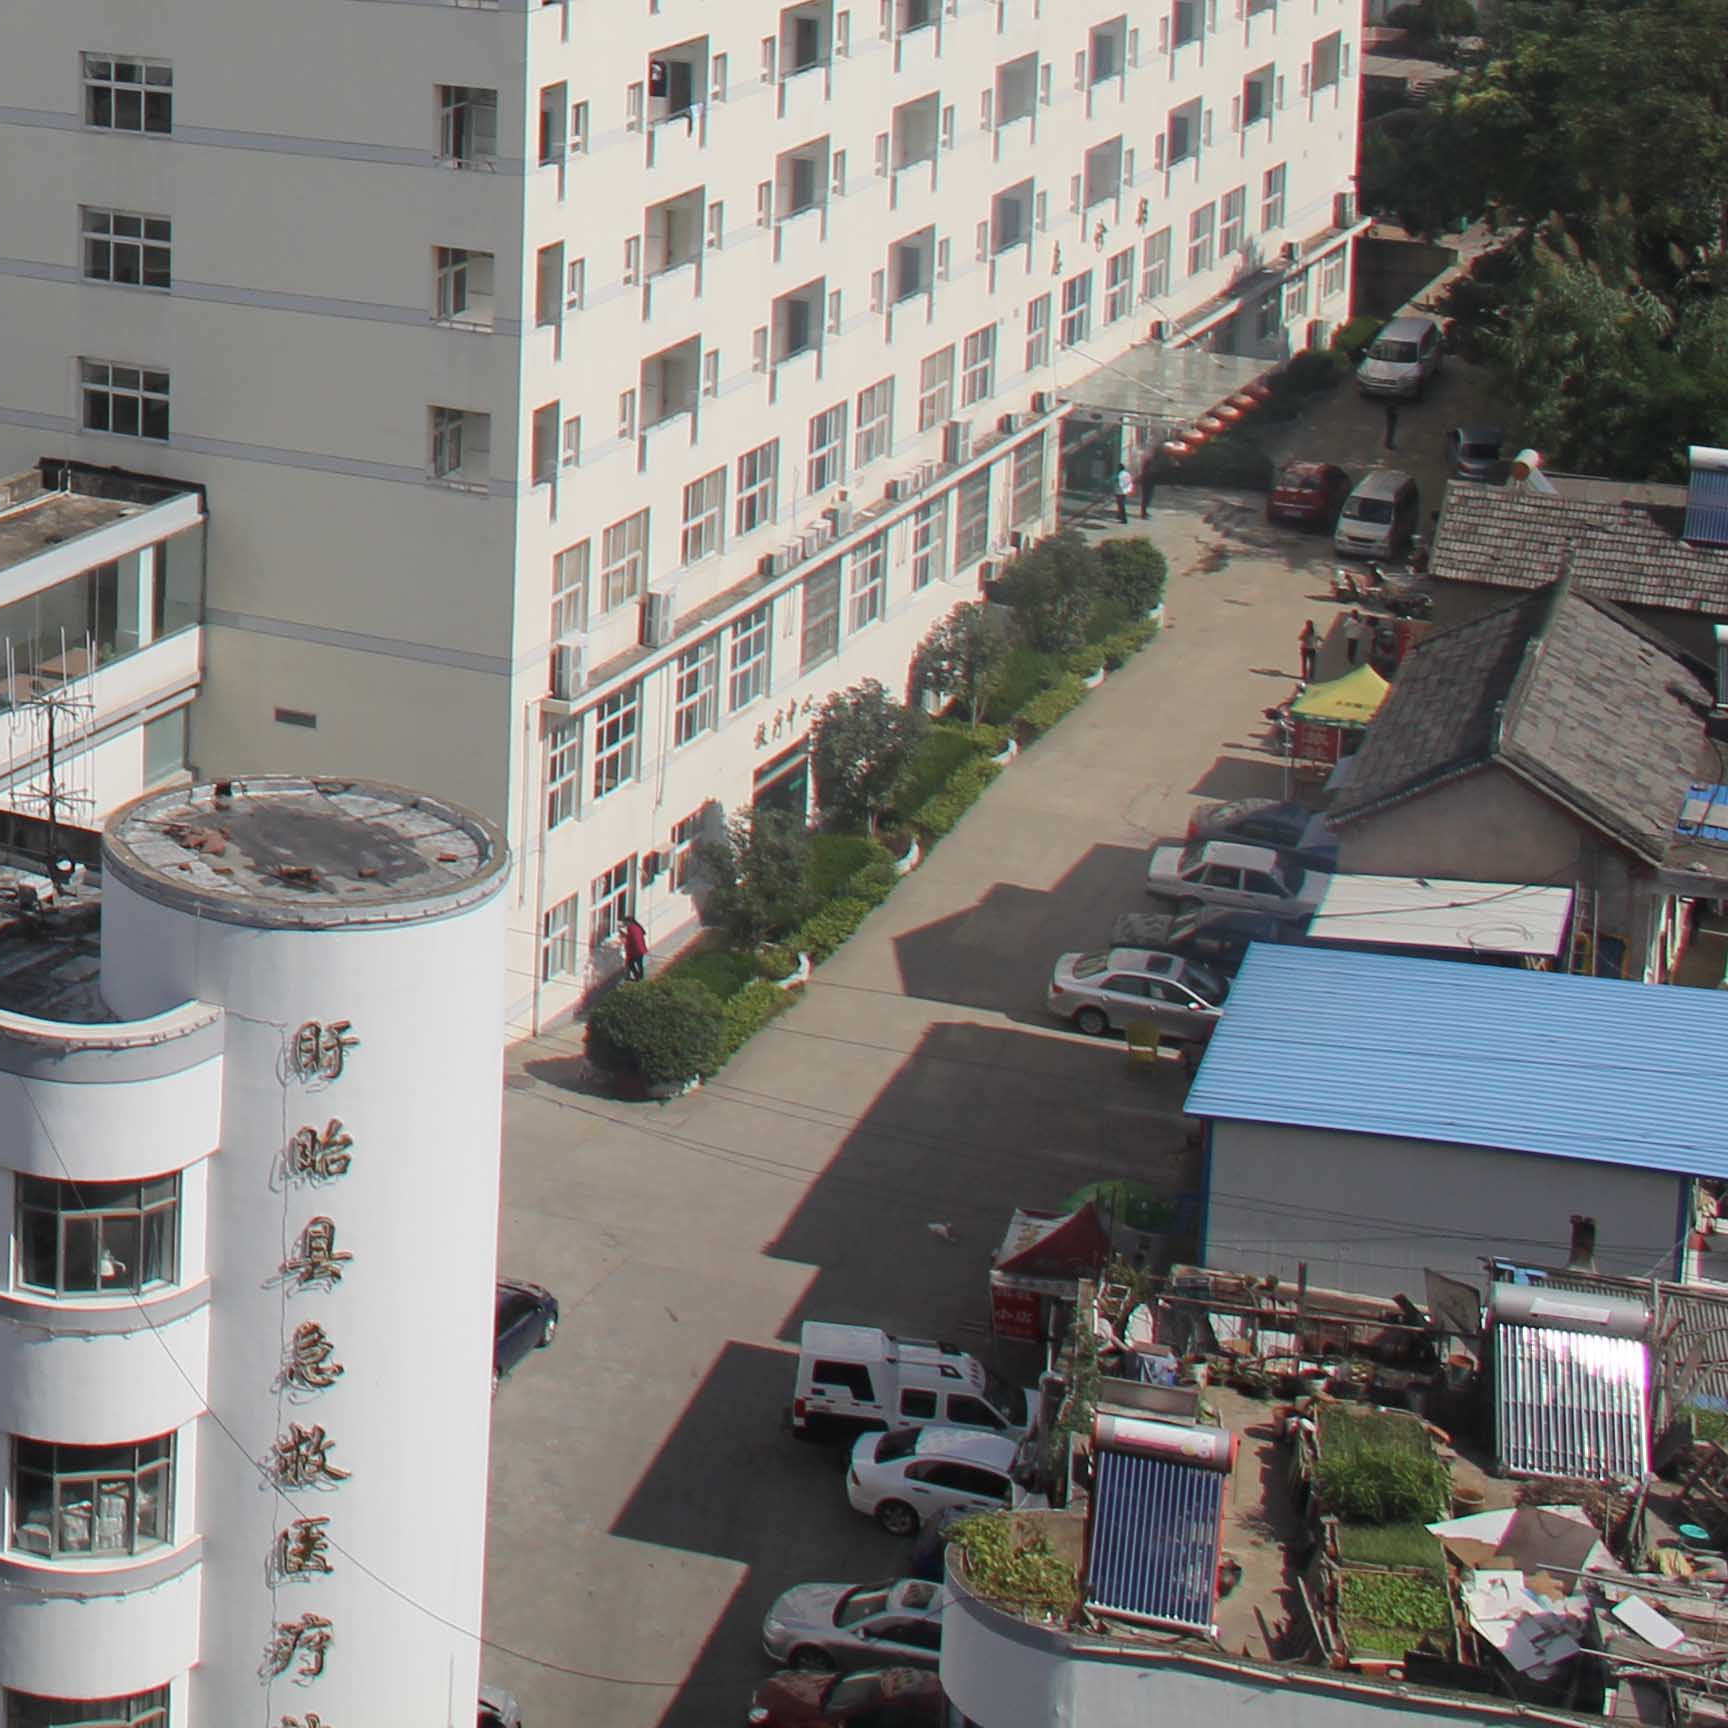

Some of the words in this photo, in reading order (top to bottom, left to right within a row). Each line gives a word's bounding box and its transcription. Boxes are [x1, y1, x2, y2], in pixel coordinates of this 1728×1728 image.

[271, 1019, 360, 1728] 盱眙县急救医疗
